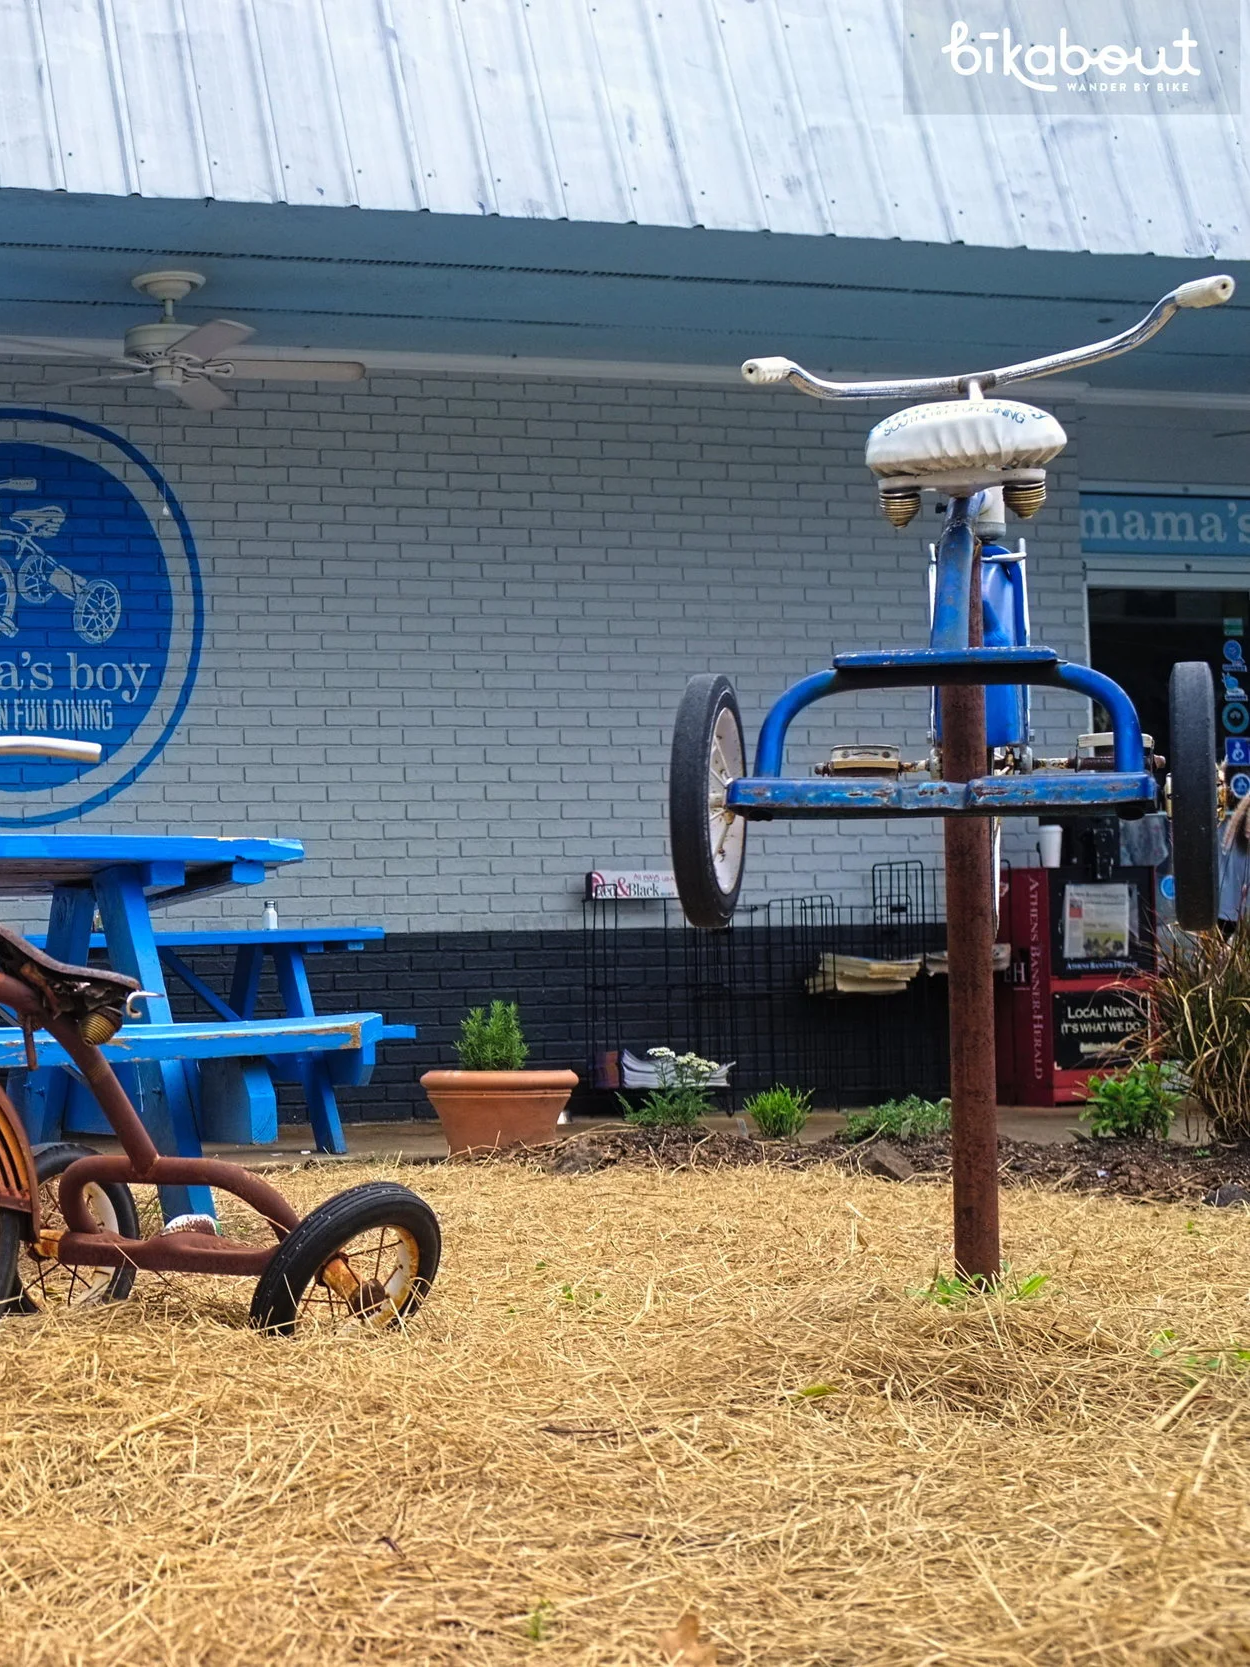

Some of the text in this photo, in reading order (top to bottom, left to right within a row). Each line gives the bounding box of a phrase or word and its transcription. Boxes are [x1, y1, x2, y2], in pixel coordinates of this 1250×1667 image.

[1079, 502, 1250, 543] mama's
[66, 652, 151, 703] boy
[14, 698, 47, 731] FUN
[53, 698, 113, 731] DINING
[1029, 877, 1040, 941] ATHENS
[1067, 1006, 1102, 1019] LOCAL
[1079, 1021, 1107, 1034] WHAT
[1108, 1021, 1124, 1032] WE
